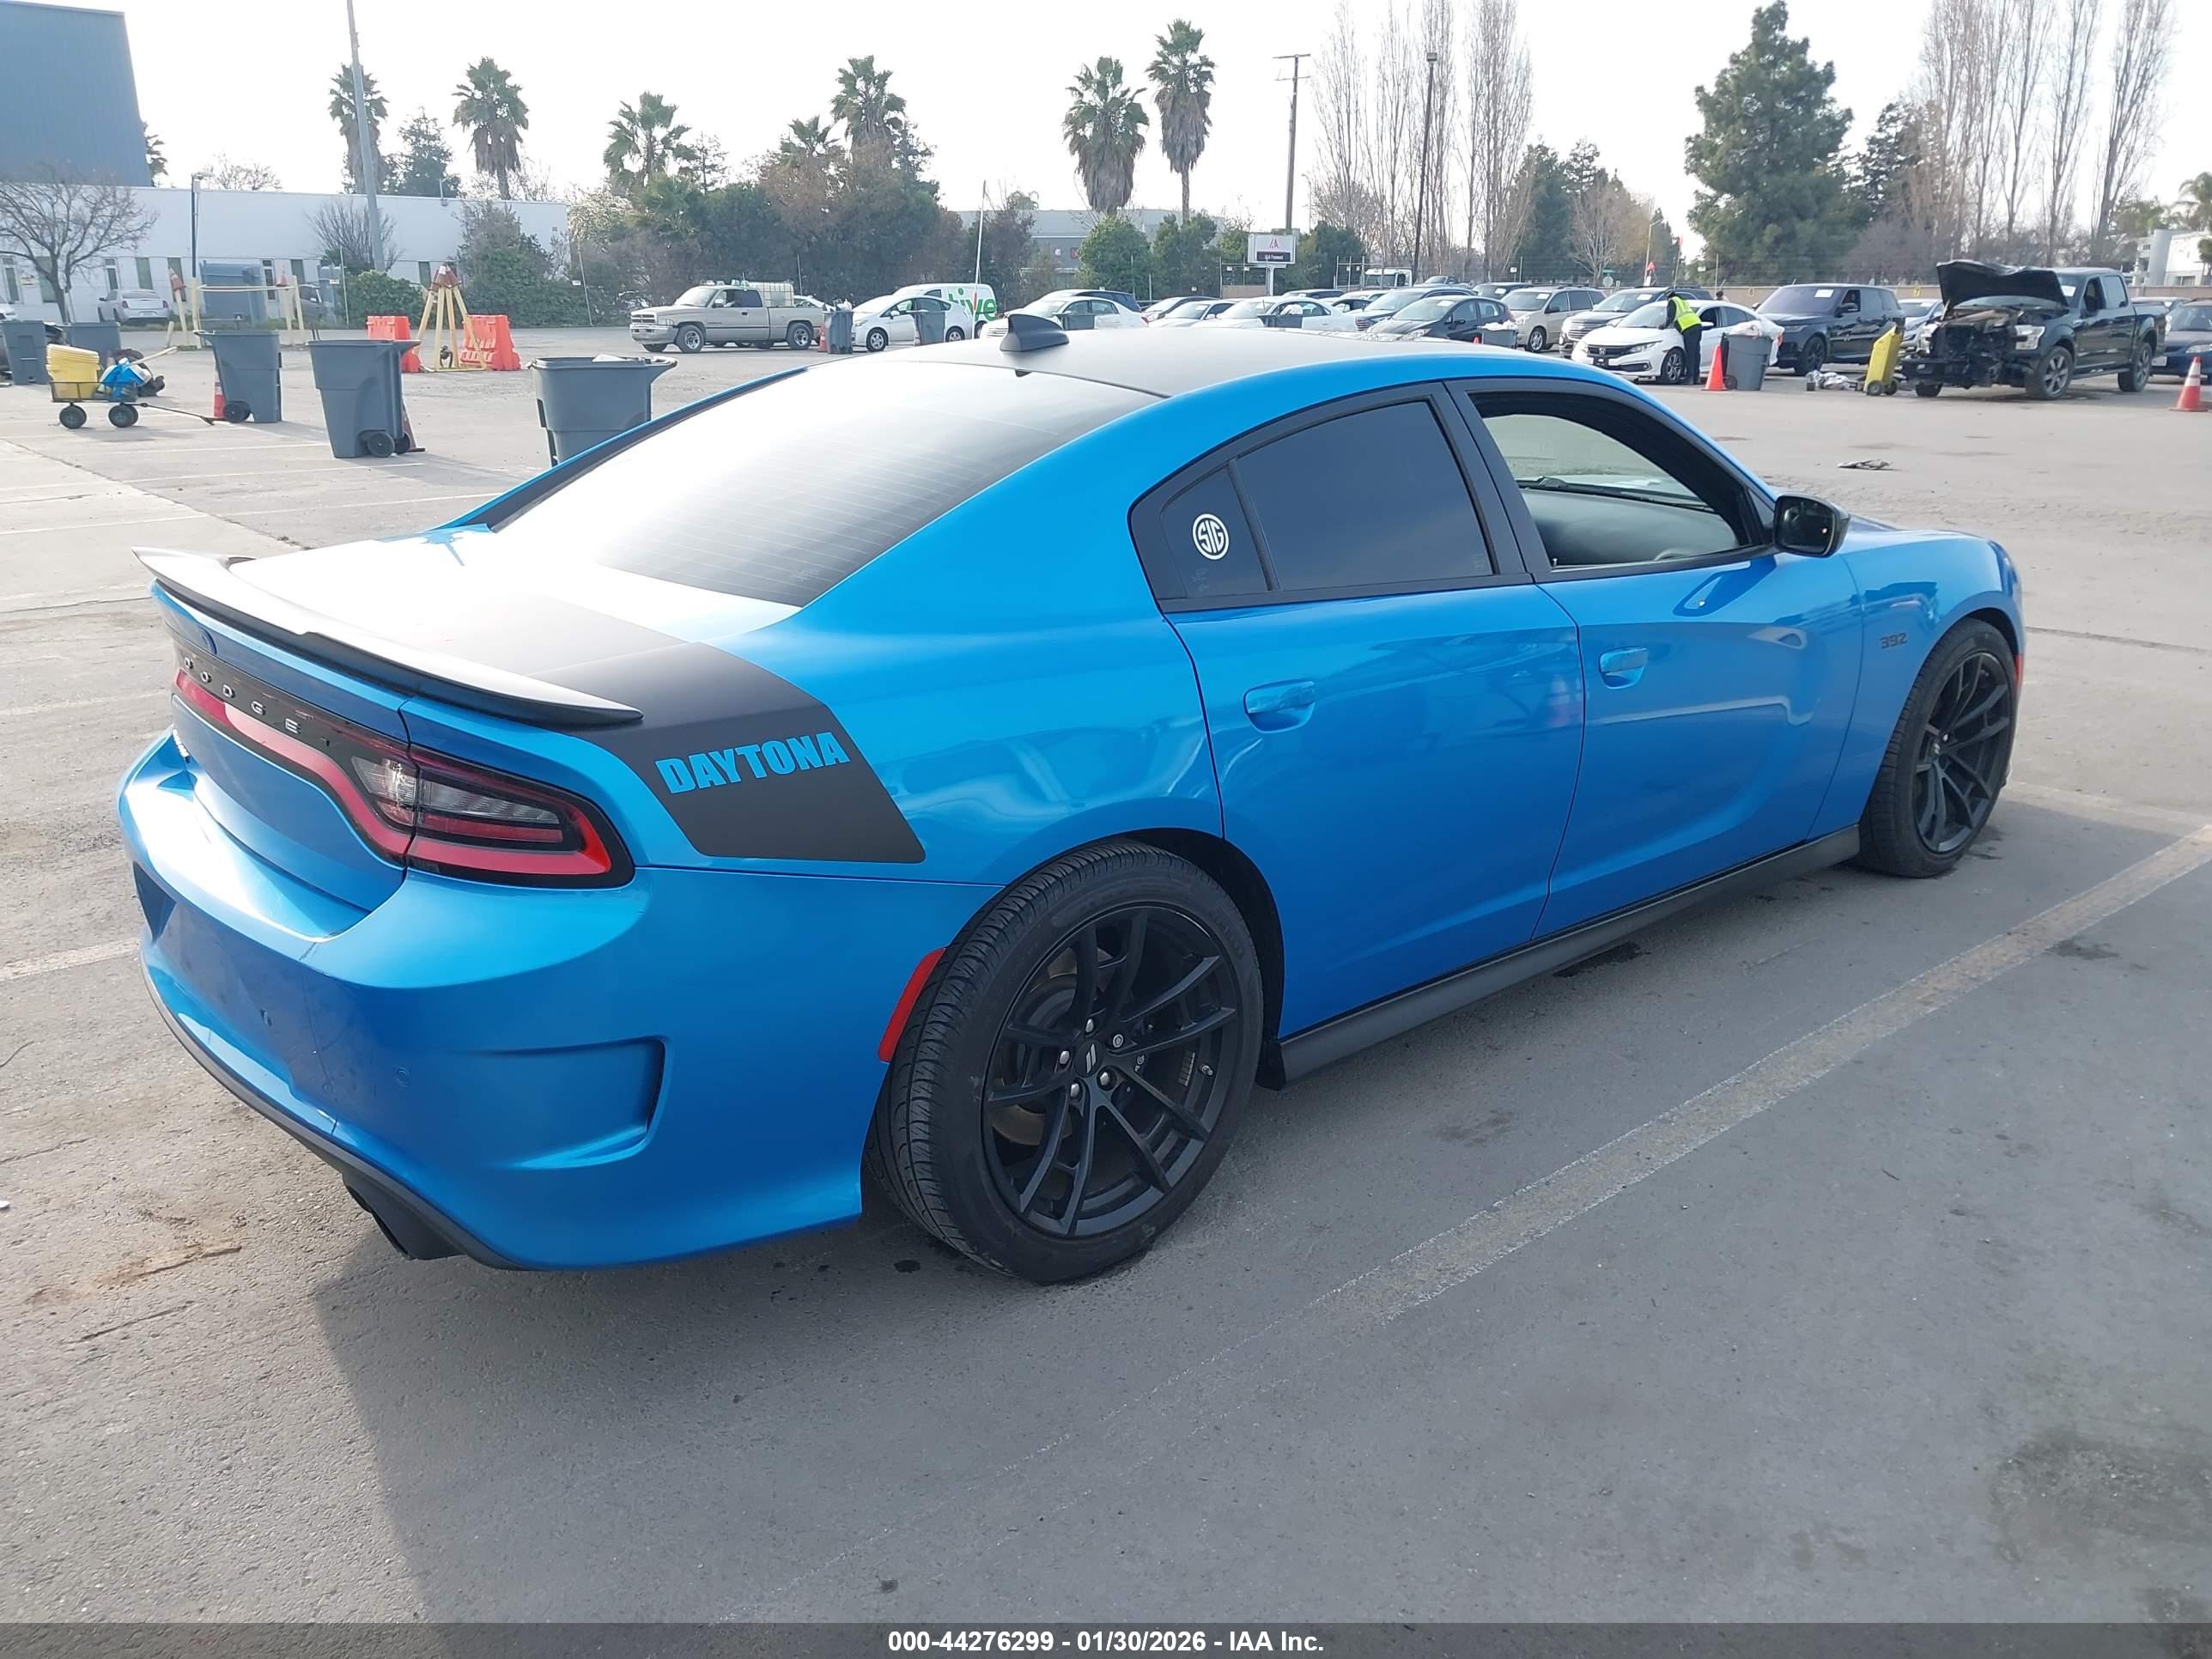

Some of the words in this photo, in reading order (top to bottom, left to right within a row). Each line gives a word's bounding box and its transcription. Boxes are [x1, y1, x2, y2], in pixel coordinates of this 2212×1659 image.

[1198, 520, 1224, 554] SIG
[1881, 632, 1908, 649] 392
[184, 657, 300, 734] DODGE
[655, 732, 851, 794] DAYTONA
